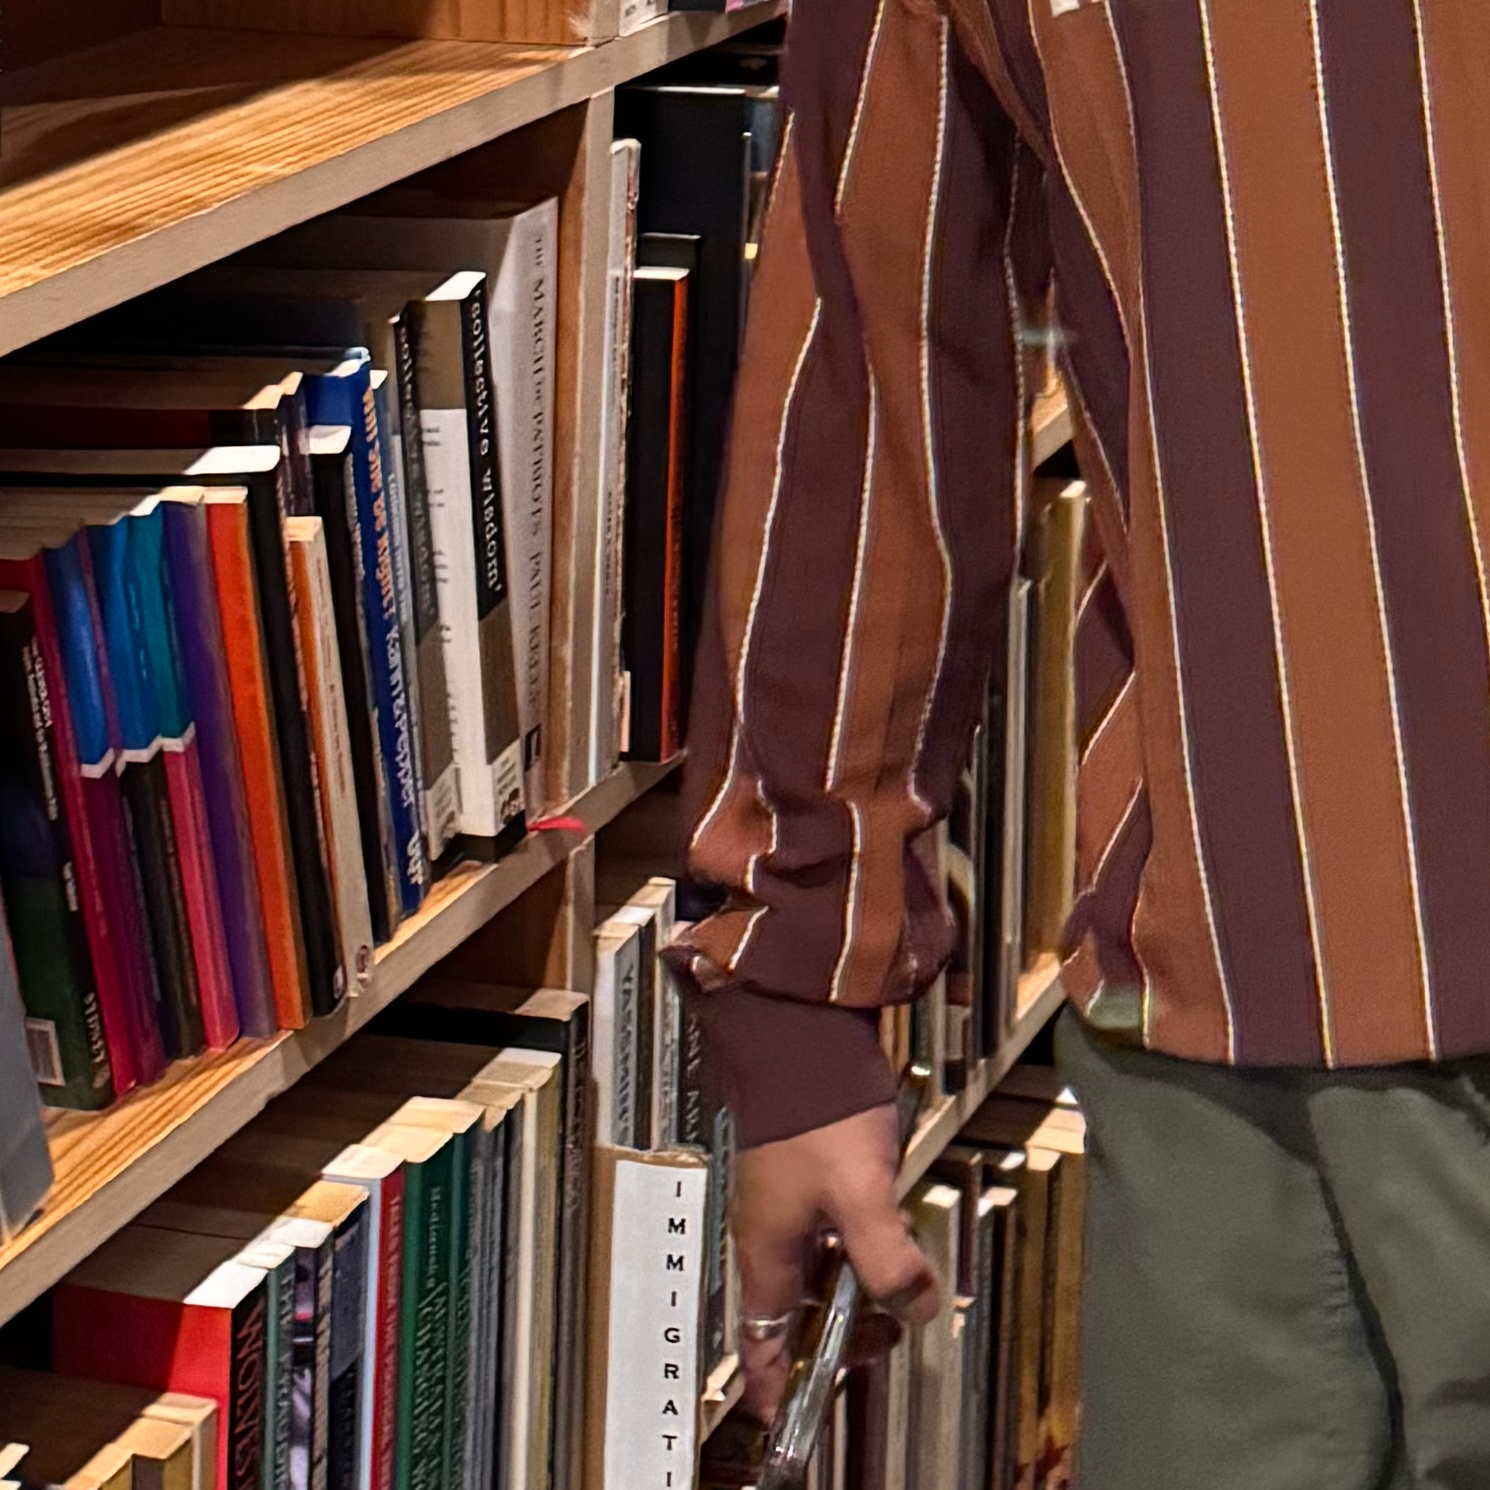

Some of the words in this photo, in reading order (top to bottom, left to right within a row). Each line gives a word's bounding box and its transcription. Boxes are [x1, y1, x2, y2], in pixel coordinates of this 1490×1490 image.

[533, 273, 546, 377] MARCH
[531, 411, 546, 537] PATRIOTS
[529, 551, 543, 611] PAUL
[528, 624, 543, 712] KELLY
[232, 1303, 265, 1477] WOLVES
[661, 1181, 687, 1489] IMMIGRATI
